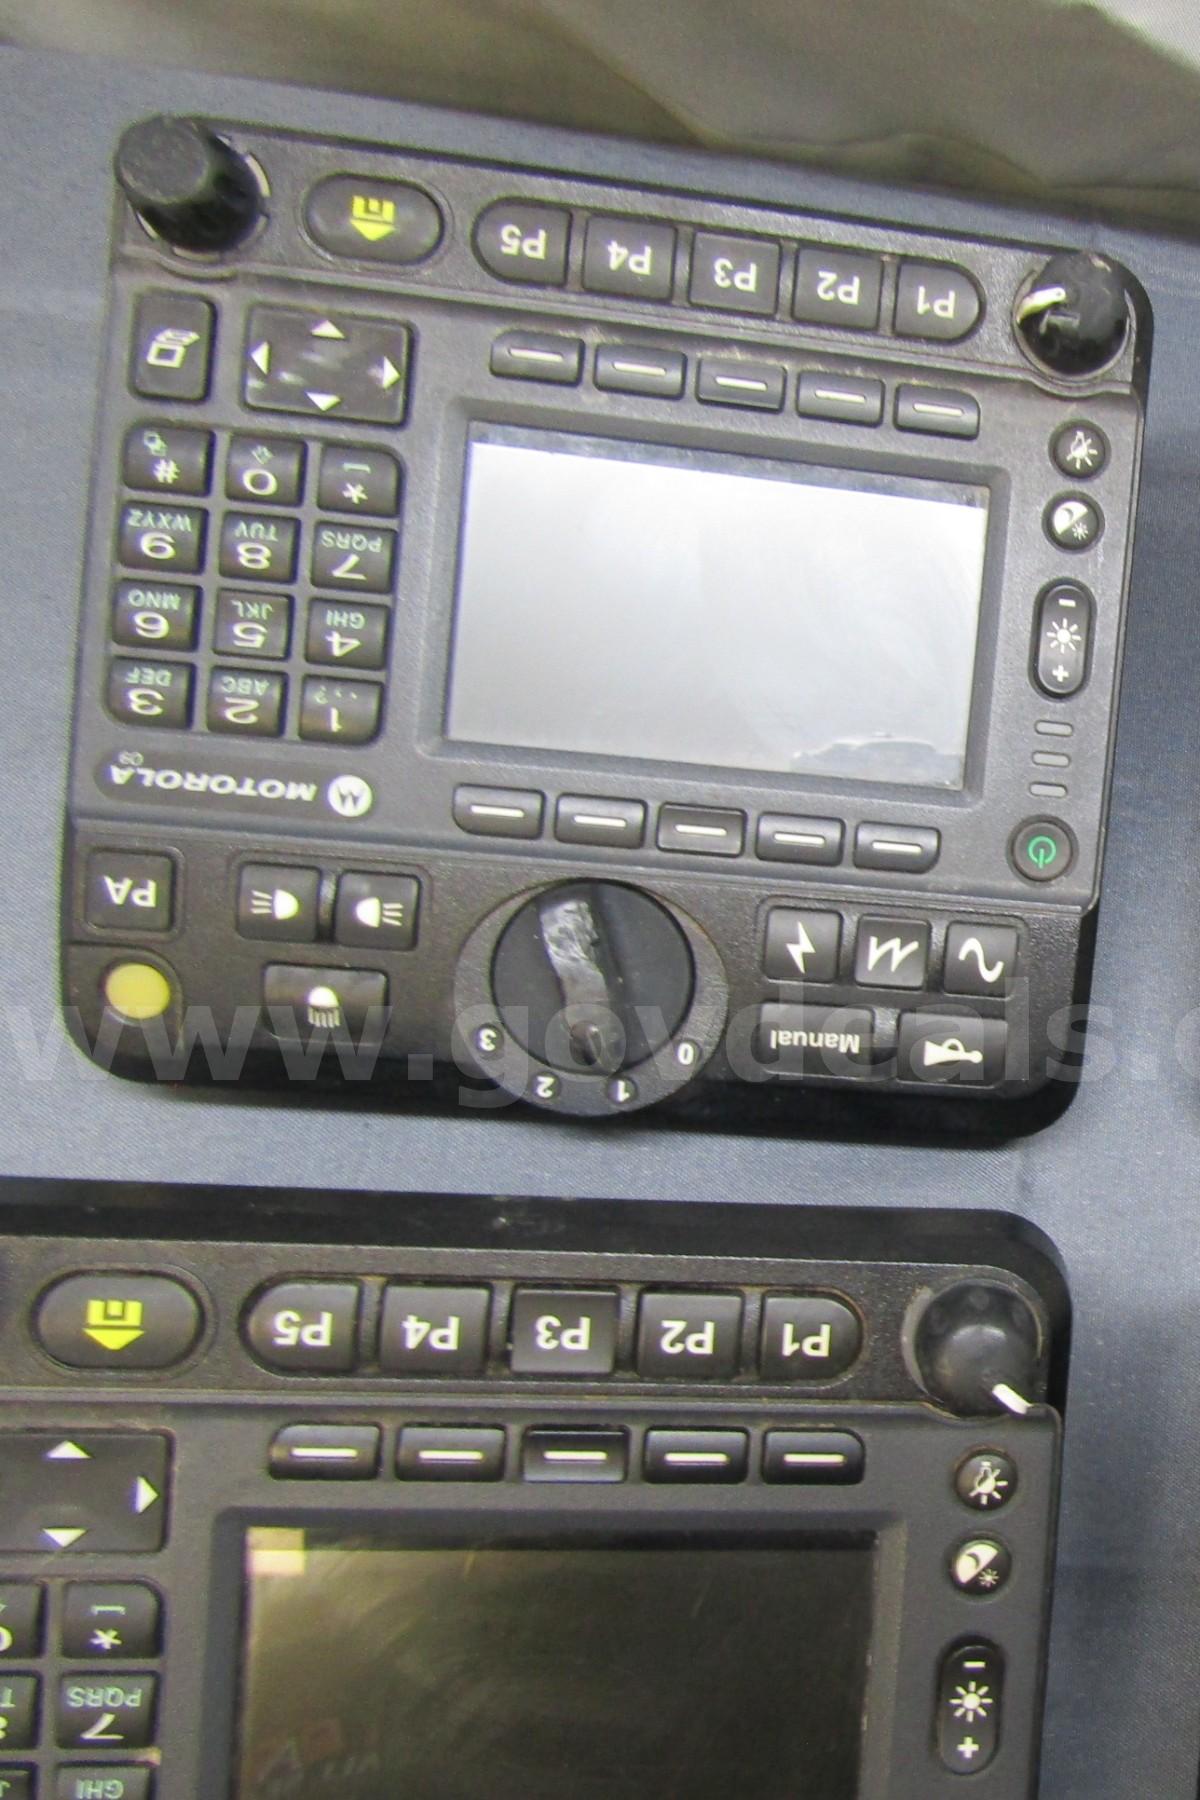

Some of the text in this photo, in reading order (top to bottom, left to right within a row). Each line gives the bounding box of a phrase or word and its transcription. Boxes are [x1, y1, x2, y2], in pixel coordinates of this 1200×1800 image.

[501, 224, 547, 260] P5
[608, 240, 653, 275] P4
[714, 258, 757, 293] P3
[816, 270, 860, 305] P2
[917, 285, 956, 318] P1
[128, 509, 192, 531] WXYZ
[235, 520, 278, 542] TUV
[140, 532, 175, 559] 9
[322, 531, 382, 552] PQRS
[237, 542, 271, 569] 8
[331, 554, 366, 580] 7
[128, 590, 181, 610] MNO
[231, 600, 273, 620] JKL
[133, 611, 170, 638] 6
[326, 610, 365, 629] GHI
[232, 622, 268, 648] 5
[325, 631, 361, 657] 4
[126, 667, 172, 687] DEF
[221, 676, 269, 695] ABC
[128, 688, 163, 715] 3
[224, 697, 259, 724] 2
[330, 708, 342, 732] 1
[110, 765, 318, 801] MOTOROLA
[104, 875, 157, 908] PA
[480, 1030, 498, 1051] 3
[770, 1029, 861, 1055] Manual
[677, 1043, 695, 1066] 0
[536, 1076, 555, 1098] 2
[613, 1080, 630, 1102] 1
[272, 1310, 333, 1347] P5
[402, 1314, 460, 1351] P4
[535, 1315, 591, 1351] P3
[660, 1319, 715, 1355] P2
[781, 1323, 831, 1358] P1
[67, 1686, 142, 1707] PQRS
[80, 1713, 124, 1740] 7
[76, 1779, 124, 1800] GHI
